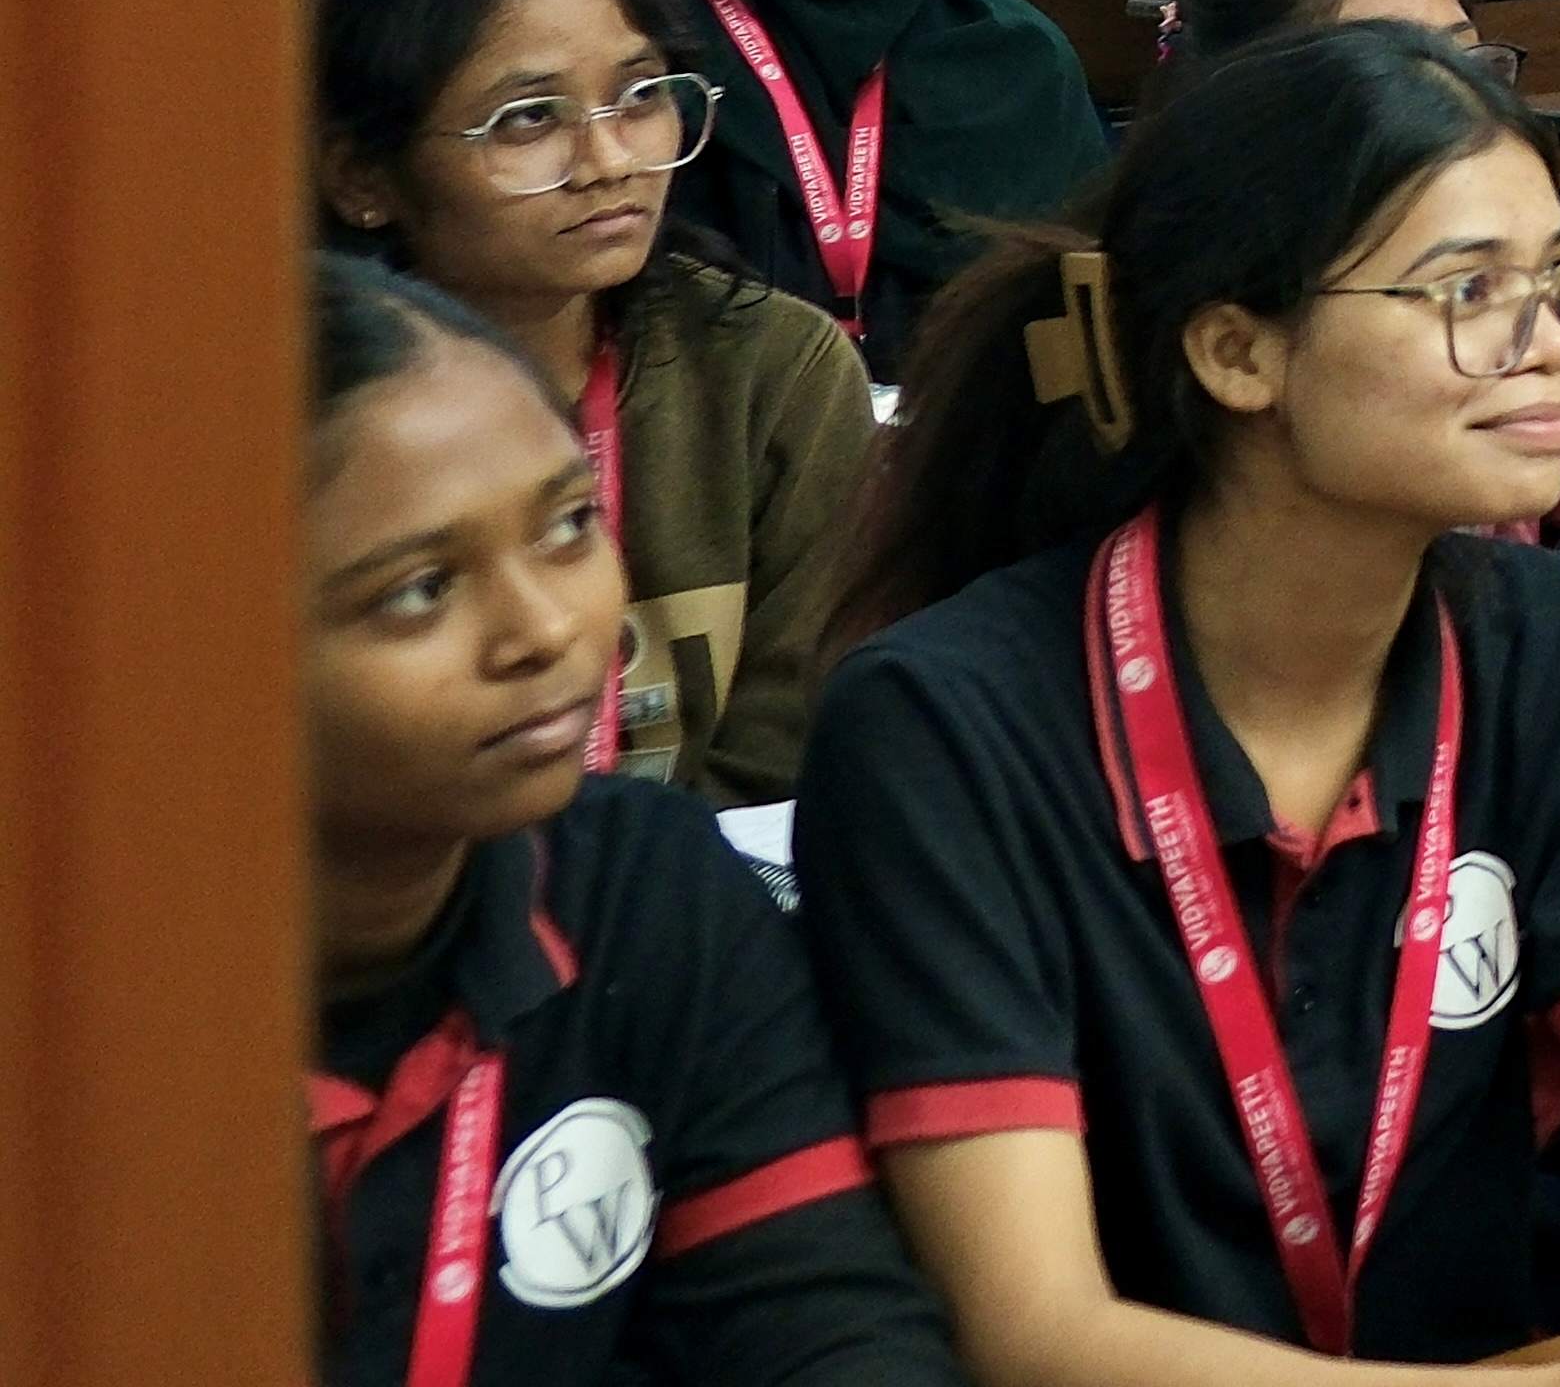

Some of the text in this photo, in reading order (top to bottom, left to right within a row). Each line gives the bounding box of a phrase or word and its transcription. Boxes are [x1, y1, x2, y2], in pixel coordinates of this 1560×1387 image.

[789, 133, 829, 225] VIDYAPEETH
[847, 125, 870, 219] VIDYAPEETH
[1106, 527, 1143, 656] VIDYAPEE
[1145, 793, 1212, 952] VIDYAPEETH
[1416, 740, 1448, 901] VIDYAPEETH
[1238, 1075, 1297, 1217] VIDYAPEETH
[1361, 1045, 1408, 1208] VIDYAPEETH
